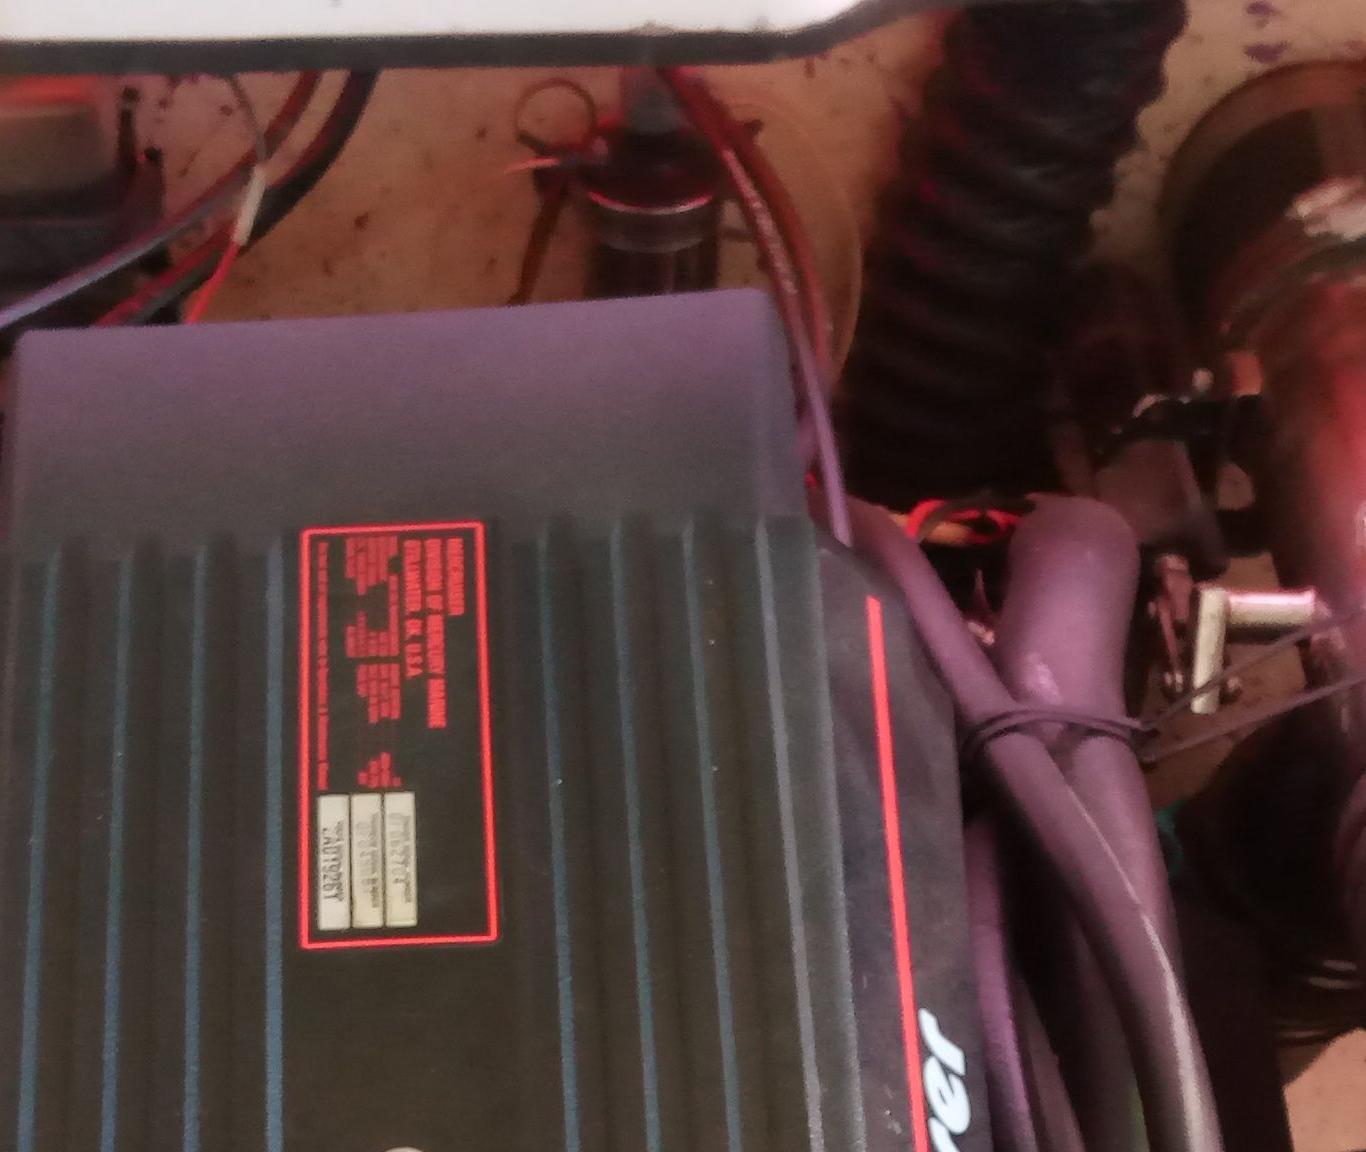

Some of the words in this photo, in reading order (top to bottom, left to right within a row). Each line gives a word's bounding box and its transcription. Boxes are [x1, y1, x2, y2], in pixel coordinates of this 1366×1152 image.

[426, 594, 444, 611] OF
[426, 614, 445, 674] MERCURY
[428, 679, 447, 728] MARINE
